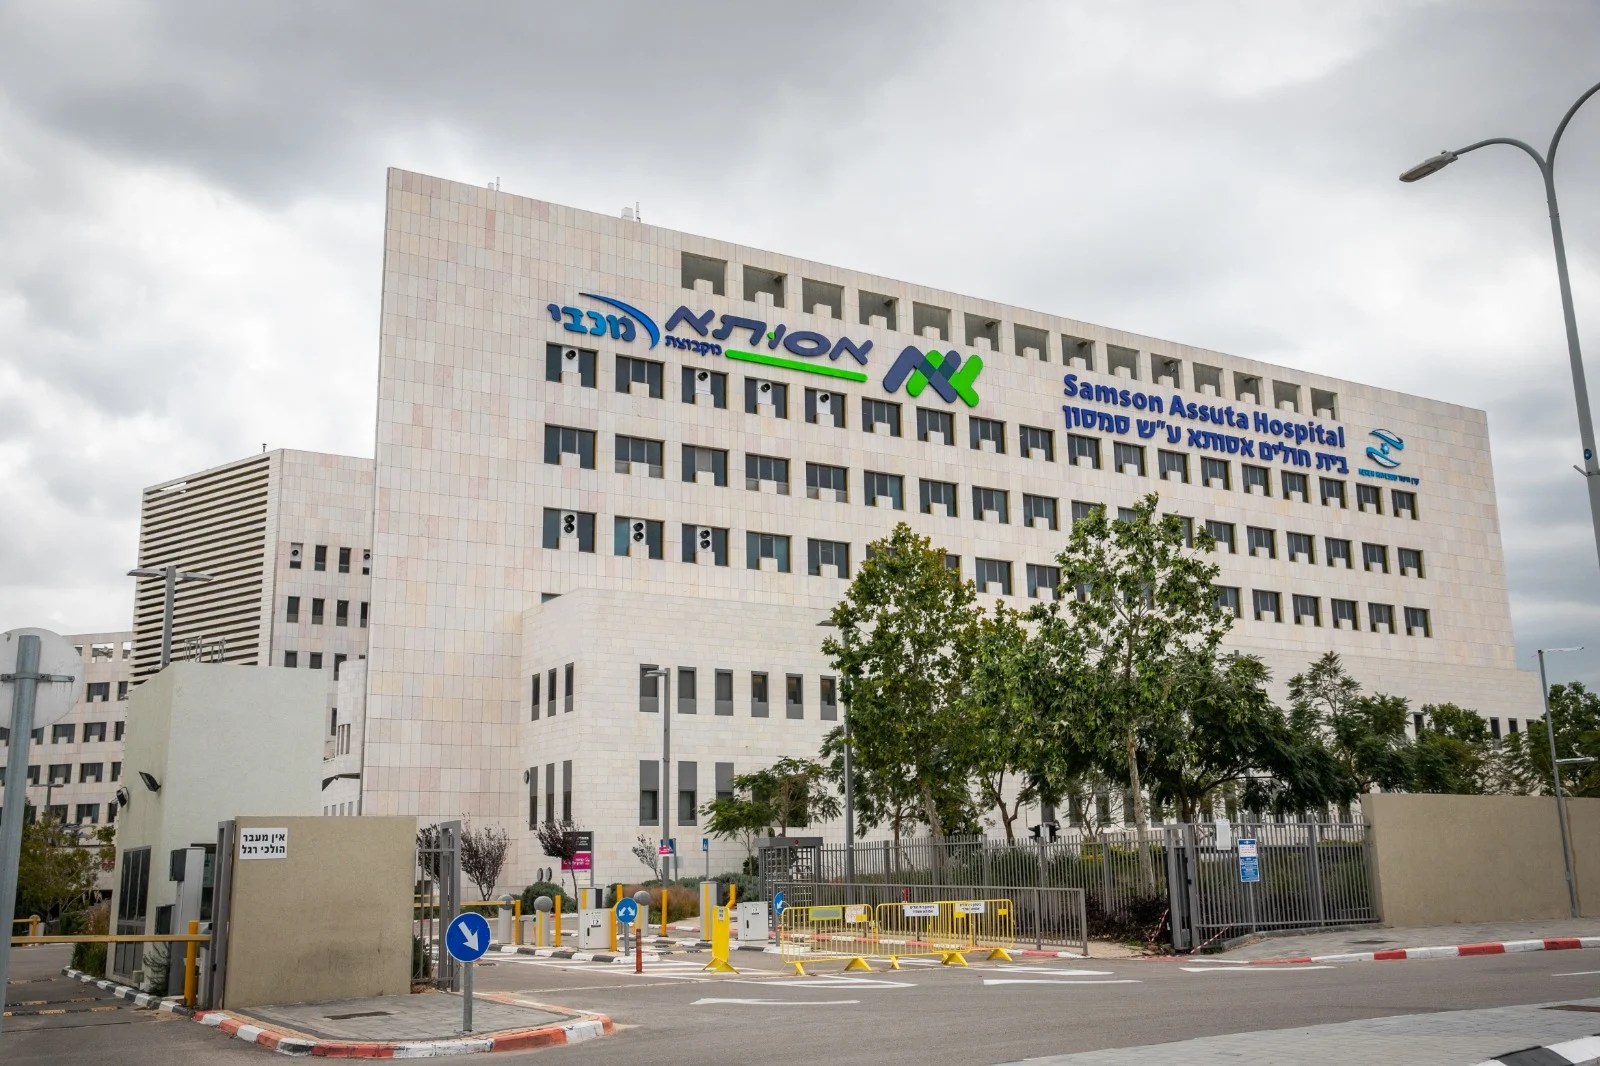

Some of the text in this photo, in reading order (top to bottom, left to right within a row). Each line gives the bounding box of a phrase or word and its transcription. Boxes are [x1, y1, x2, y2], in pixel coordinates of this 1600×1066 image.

[547, 303, 636, 342] מכבי
[665, 335, 722, 356] מקבוצת
[1062, 404, 1131, 435] סמסון
[1063, 373, 1346, 448] Samson Assuta Hospital
[1187, 427, 1255, 458] אסותא
[1259, 441, 1312, 468] חולים
[1315, 451, 1350, 475] בית
[241, 844, 286, 854] הולכי רגל
[242, 833, 286, 844] אין מעבר
